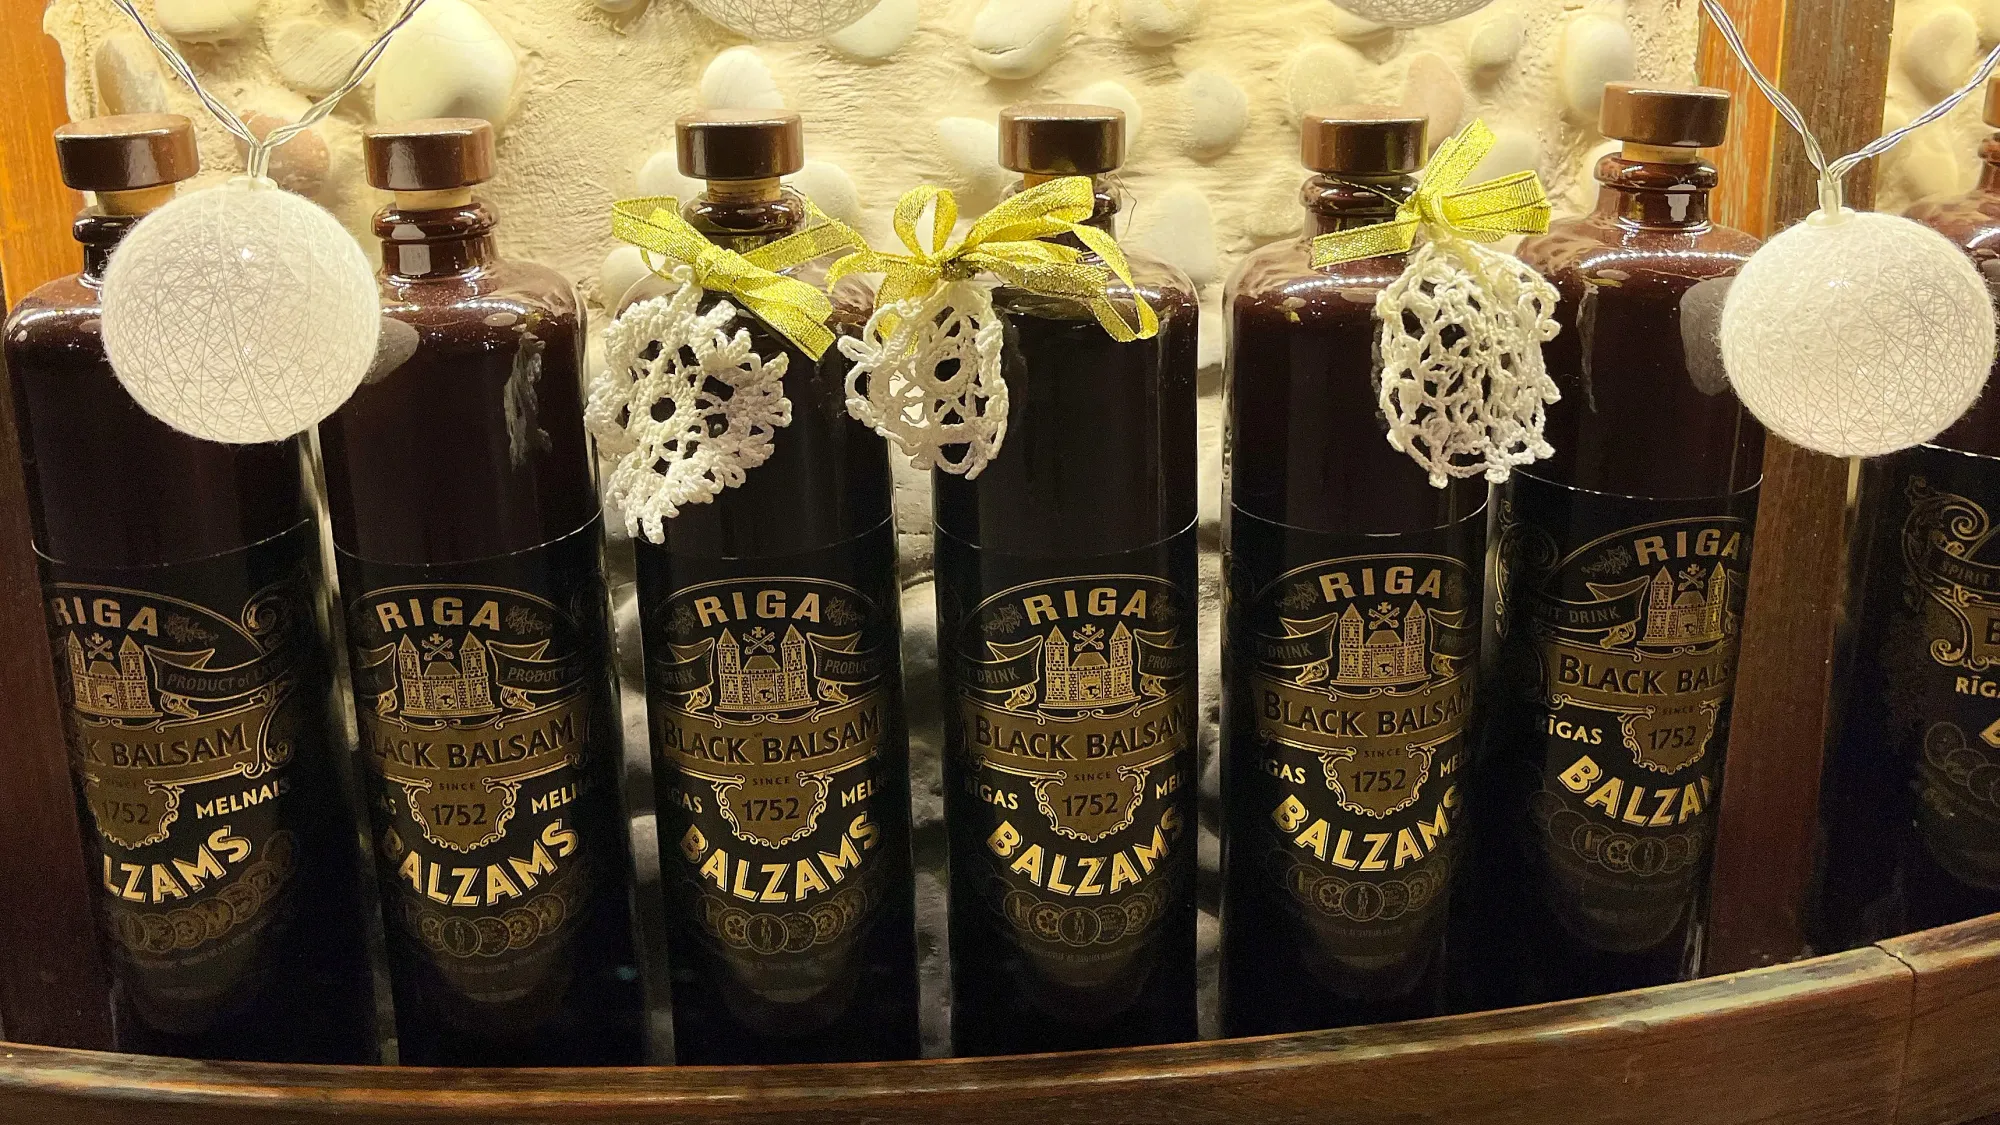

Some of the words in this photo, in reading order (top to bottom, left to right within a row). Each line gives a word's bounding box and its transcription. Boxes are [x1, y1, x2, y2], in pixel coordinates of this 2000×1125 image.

[1634, 529, 1739, 565] RIGA
[1319, 567, 1441, 602] RIGA
[52, 597, 159, 638] RIGA
[376, 596, 500, 631] RIGA
[695, 590, 820, 627] RIGA
[1022, 588, 1147, 625] RIGA
[1568, 607, 1619, 623] DRINK
[1267, 642, 1313, 659] DRINK
[168, 673, 233, 693] PRODUCT
[508, 666, 564, 682] PRODUCT
[977, 667, 1018, 684] DRINK
[1558, 654, 1668, 696] BLACK
[1264, 690, 1365, 738] BLACK
[1377, 682, 1473, 738] BALSAM
[112, 723, 251, 769] BALSAM
[363, 734, 438, 769] LACK
[448, 712, 578, 769] BALSAM
[664, 718, 755, 764] BLACK
[763, 706, 880, 764] BALSAM
[977, 715, 1077, 760] BLACK
[1648, 726, 1697, 750] 1752
[1364, 749, 1400, 758] SINCE
[439, 782, 476, 790] SINCE
[753, 776, 790, 785] SINCE
[1074, 771, 1110, 780] SINCE
[1351, 769, 1407, 792] 1752
[102, 803, 149, 825] 1752
[196, 779, 289, 819] MELNAIS
[431, 804, 487, 826] 1752
[742, 798, 799, 821] 1752
[1062, 793, 1118, 816] 1752
[380, 818, 579, 907] BALZAMS
[682, 810, 880, 904] BALZAMS
[987, 806, 1184, 897] BALZAMS
